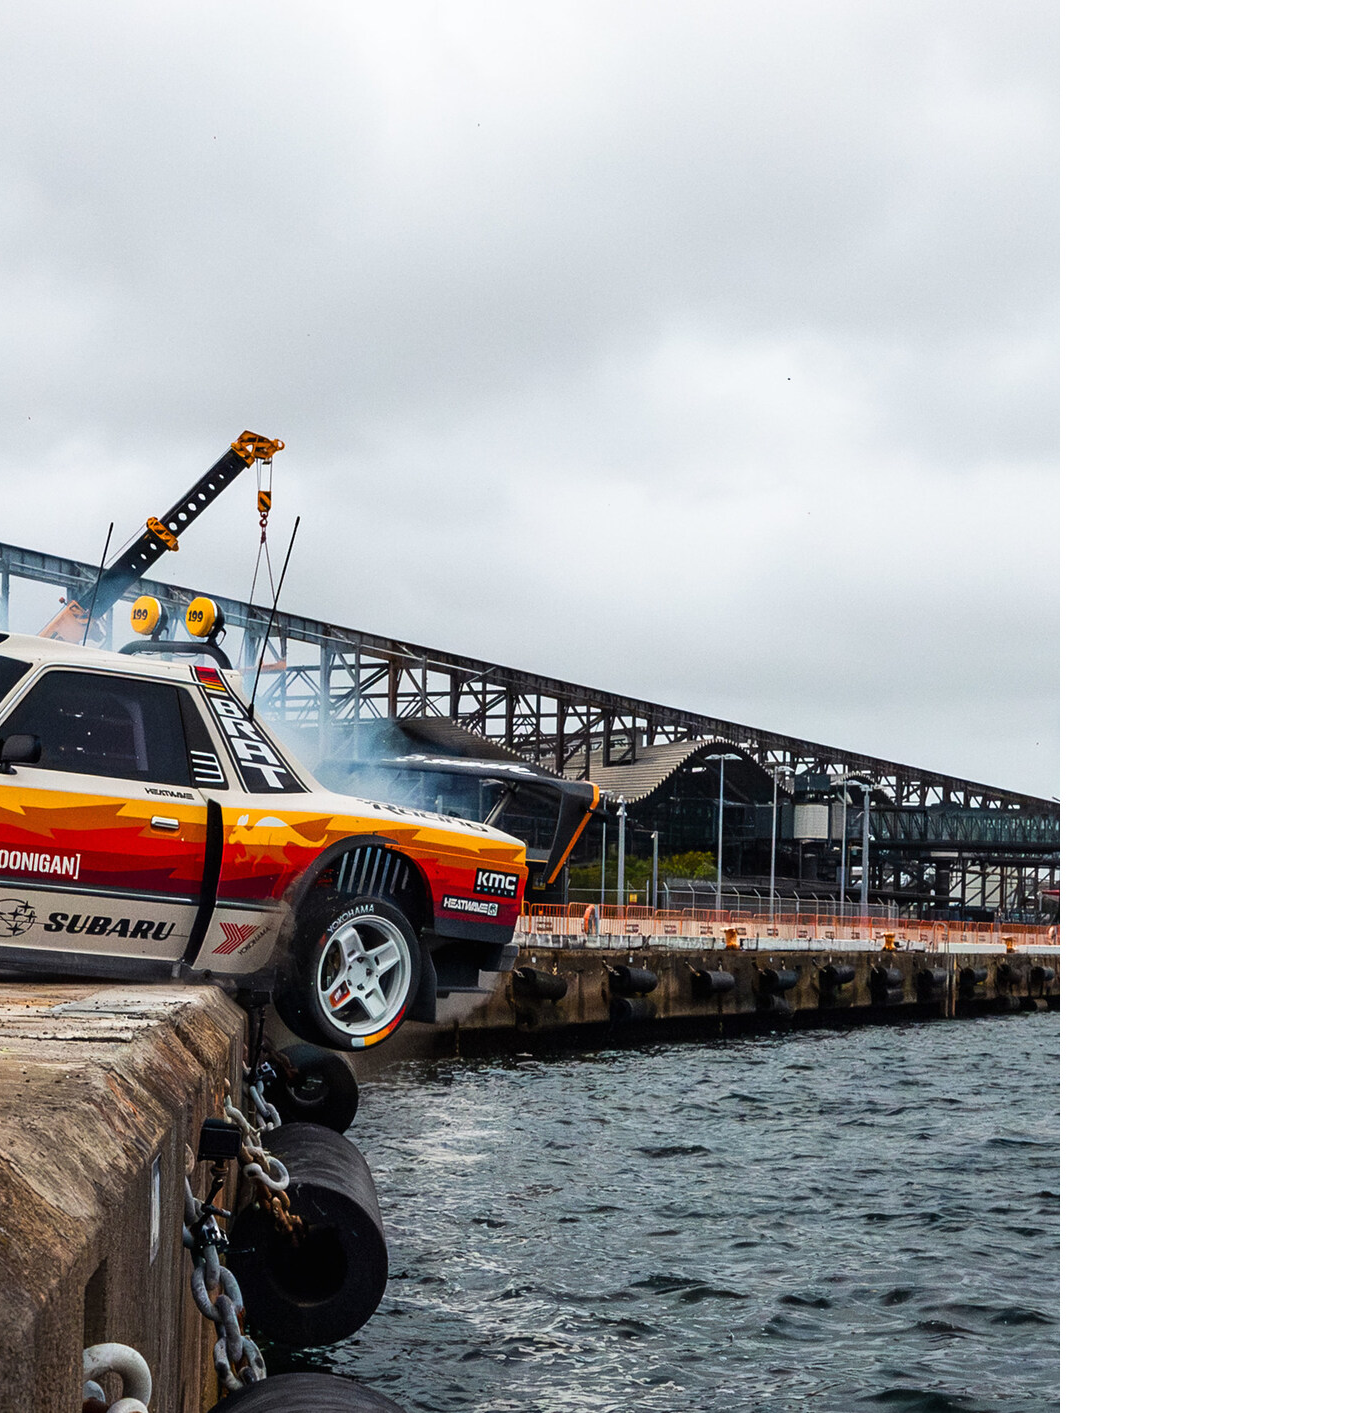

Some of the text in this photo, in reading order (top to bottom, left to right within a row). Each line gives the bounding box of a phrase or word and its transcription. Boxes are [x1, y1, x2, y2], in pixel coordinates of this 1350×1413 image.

[132, 609, 148, 621] 199
[188, 611, 204, 622] 199
[210, 697, 287, 789] BRAT
[477, 871, 517, 891] KMC
[443, 897, 489, 914] HEATWAVE
[43, 913, 176, 941] SUBARU
[327, 904, 375, 933] YOKOHAMA
